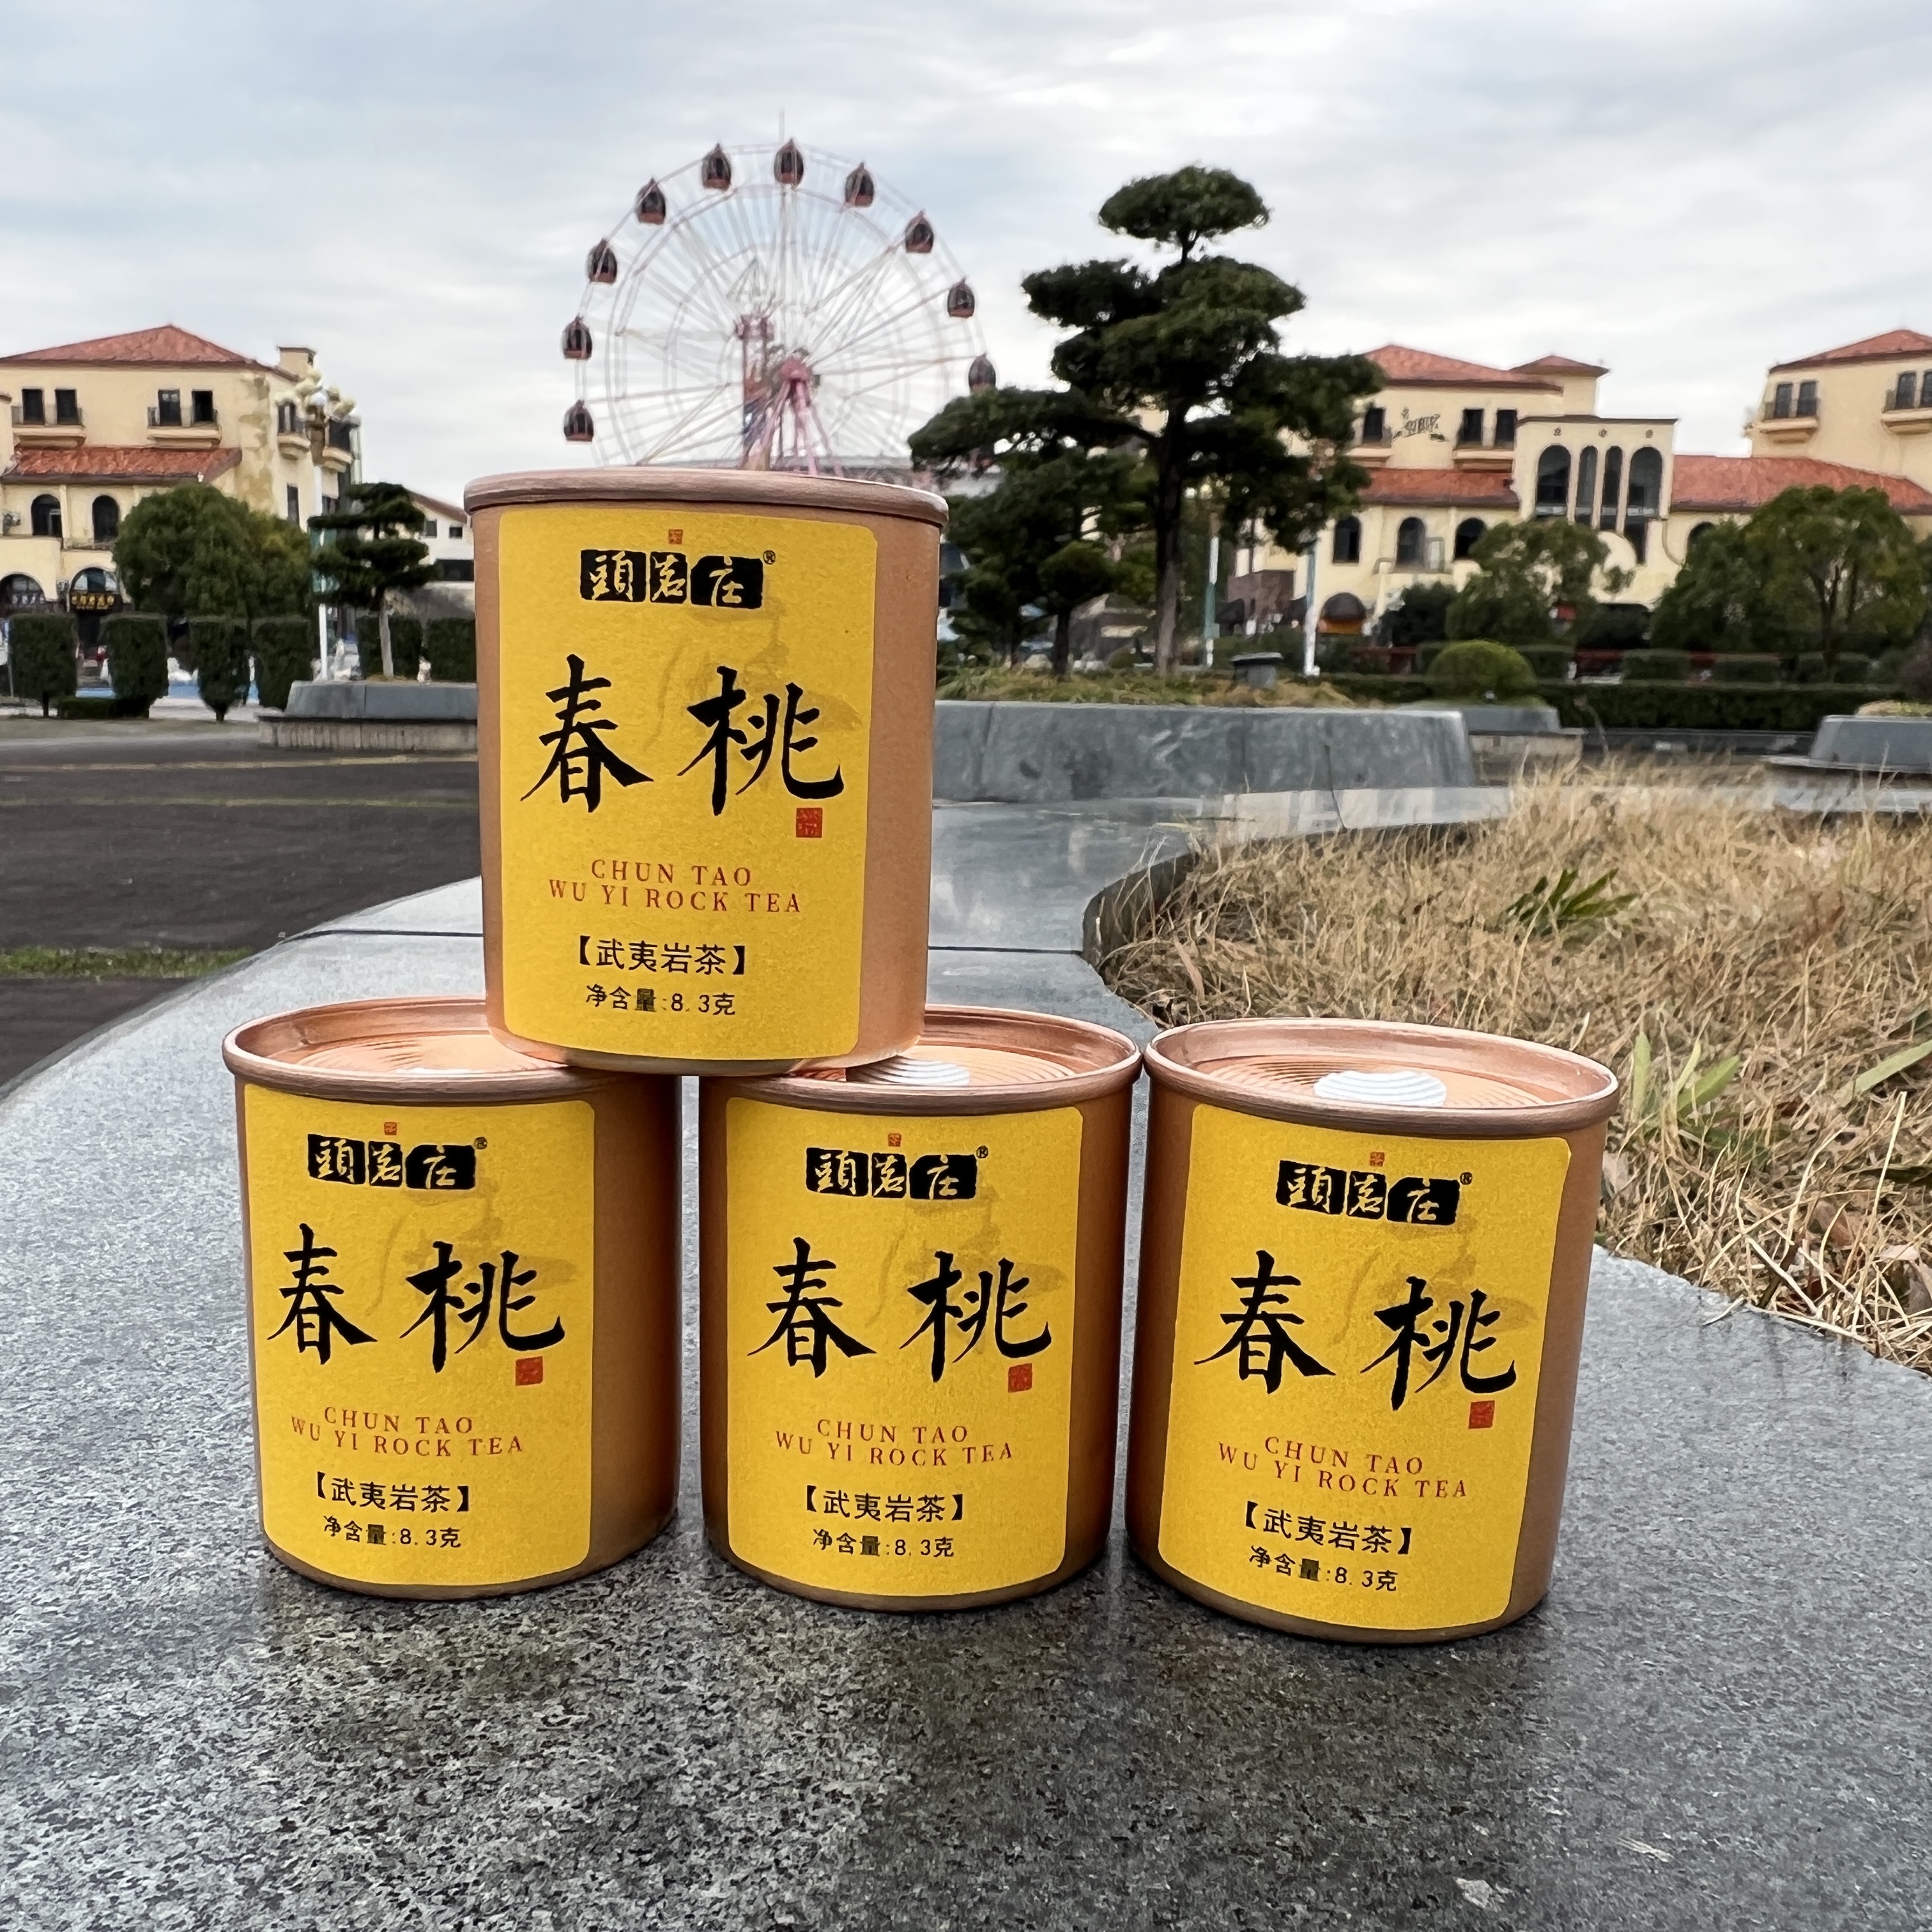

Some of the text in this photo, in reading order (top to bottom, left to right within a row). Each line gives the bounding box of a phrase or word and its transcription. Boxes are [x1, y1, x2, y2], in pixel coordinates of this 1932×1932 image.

[521, 654, 844, 816] 春桃
[591, 859, 751, 887] CHUN TAO
[549, 879, 801, 913] WU YI ROCK TEA
[267, 1223, 565, 1373] 春桃
[747, 1237, 1052, 1383] 春桃
[1193, 1250, 1516, 1411] 春桃
[291, 1416, 523, 1457] WU YI ROCK TEA
[325, 1407, 473, 1434] CHUN TAO
[817, 1419, 968, 1443] CHUN TAO
[776, 1430, 1013, 1466] WU YI ROCK TEA
[1265, 1437, 1423, 1475] CHUN TAO
[1218, 1442, 1468, 1498] WU YI ROCK TEA
